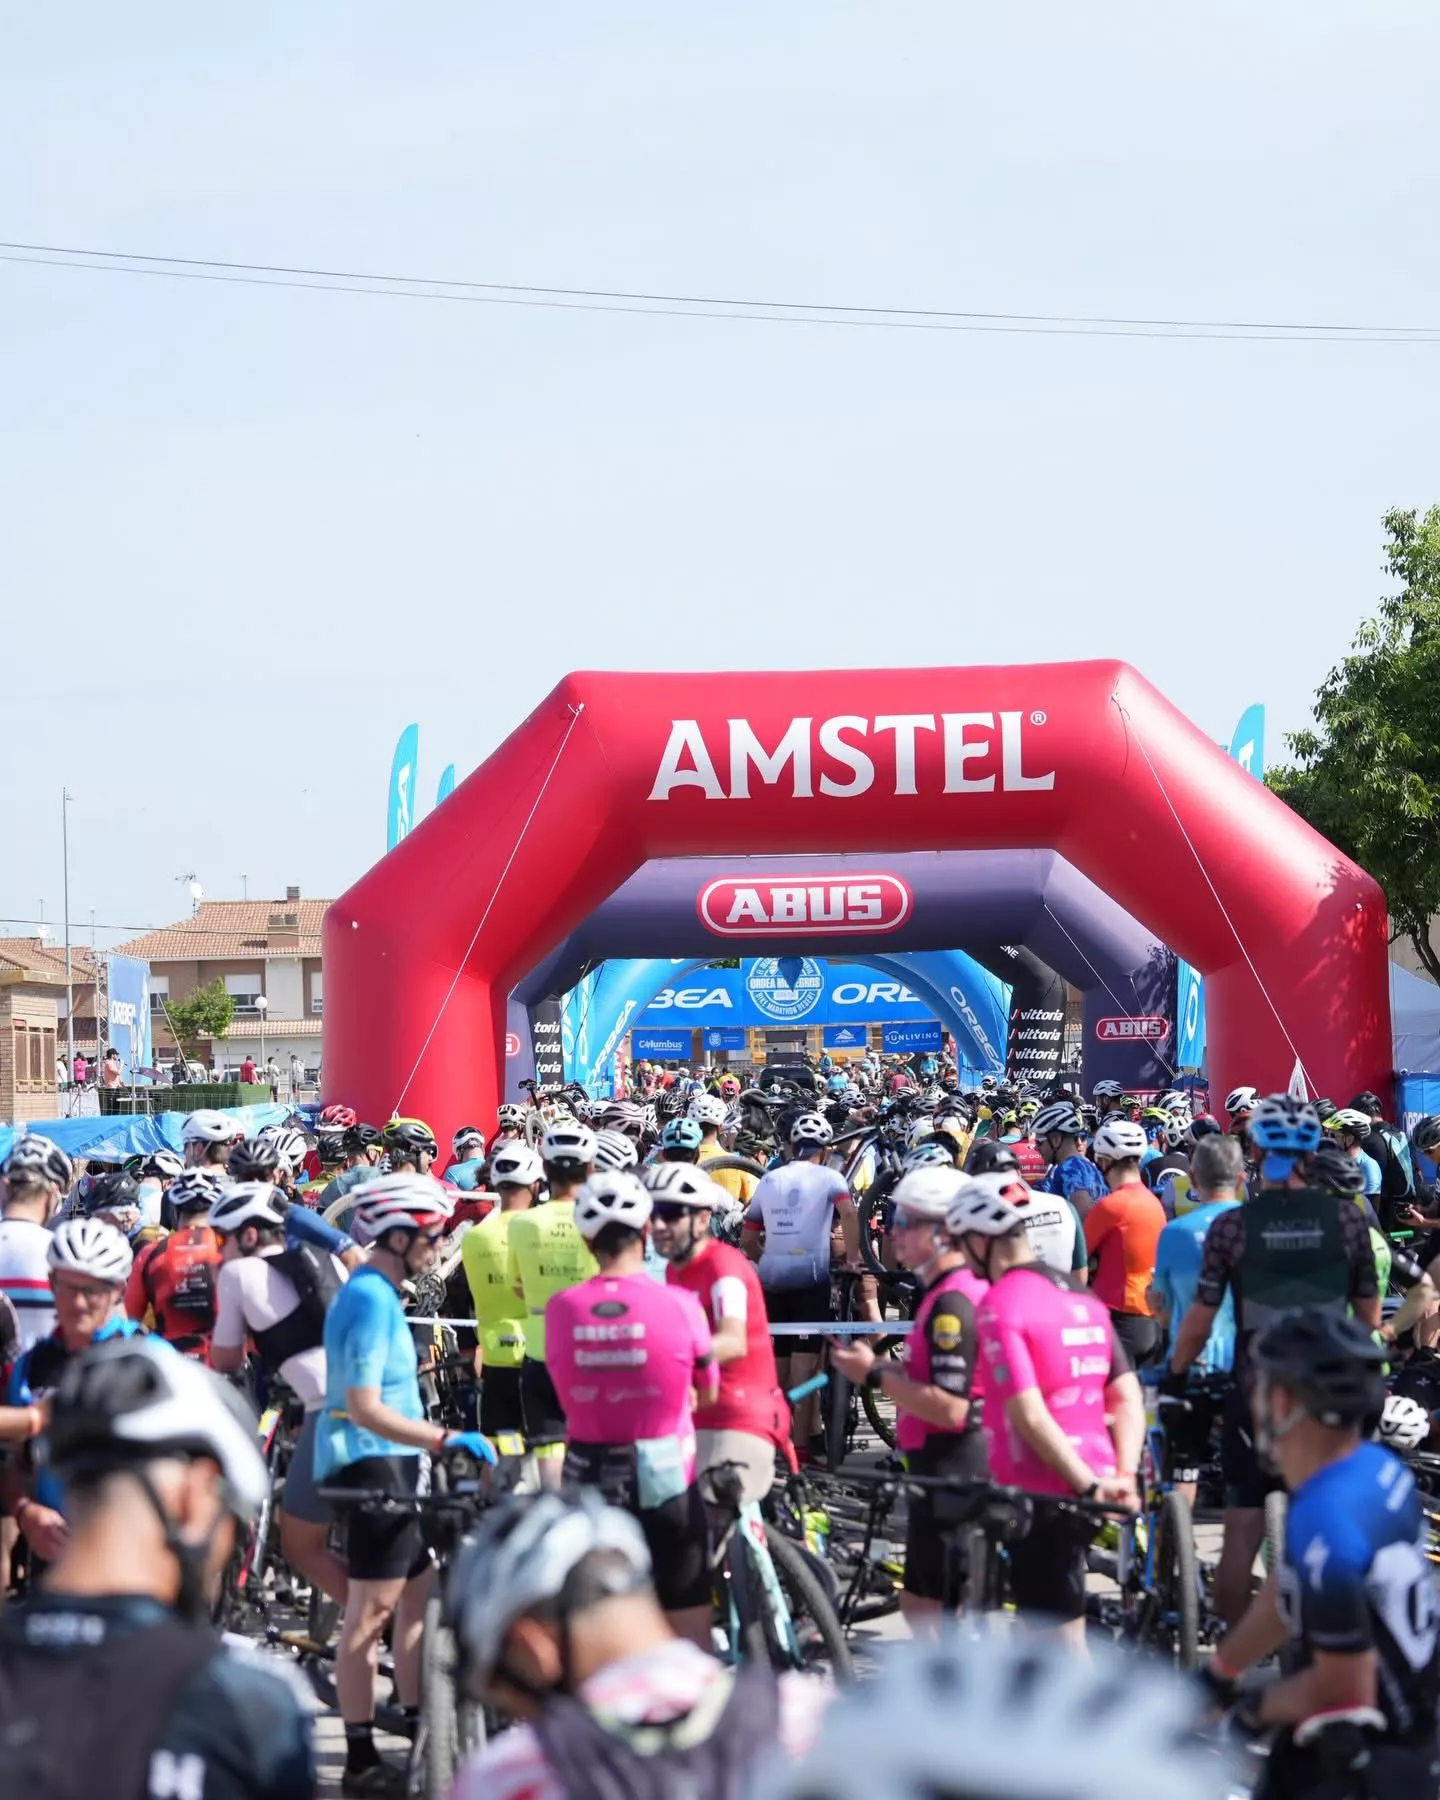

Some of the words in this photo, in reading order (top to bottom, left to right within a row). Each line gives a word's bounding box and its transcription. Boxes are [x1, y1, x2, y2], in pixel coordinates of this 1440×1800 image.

[726, 885, 883, 923] ABUS
[1020, 1008, 1064, 1021] vittoria
[950, 986, 1006, 1074] ORBEA
[1018, 1028, 1062, 1041] vittoria
[1103, 1022, 1161, 1036] ABUS
[884, 1032, 939, 1041] SUNLIVING
[638, 1039, 682, 1048] Columbus
[1015, 1048, 1059, 1061] vittoria
[1013, 1067, 1057, 1080] vittoria
